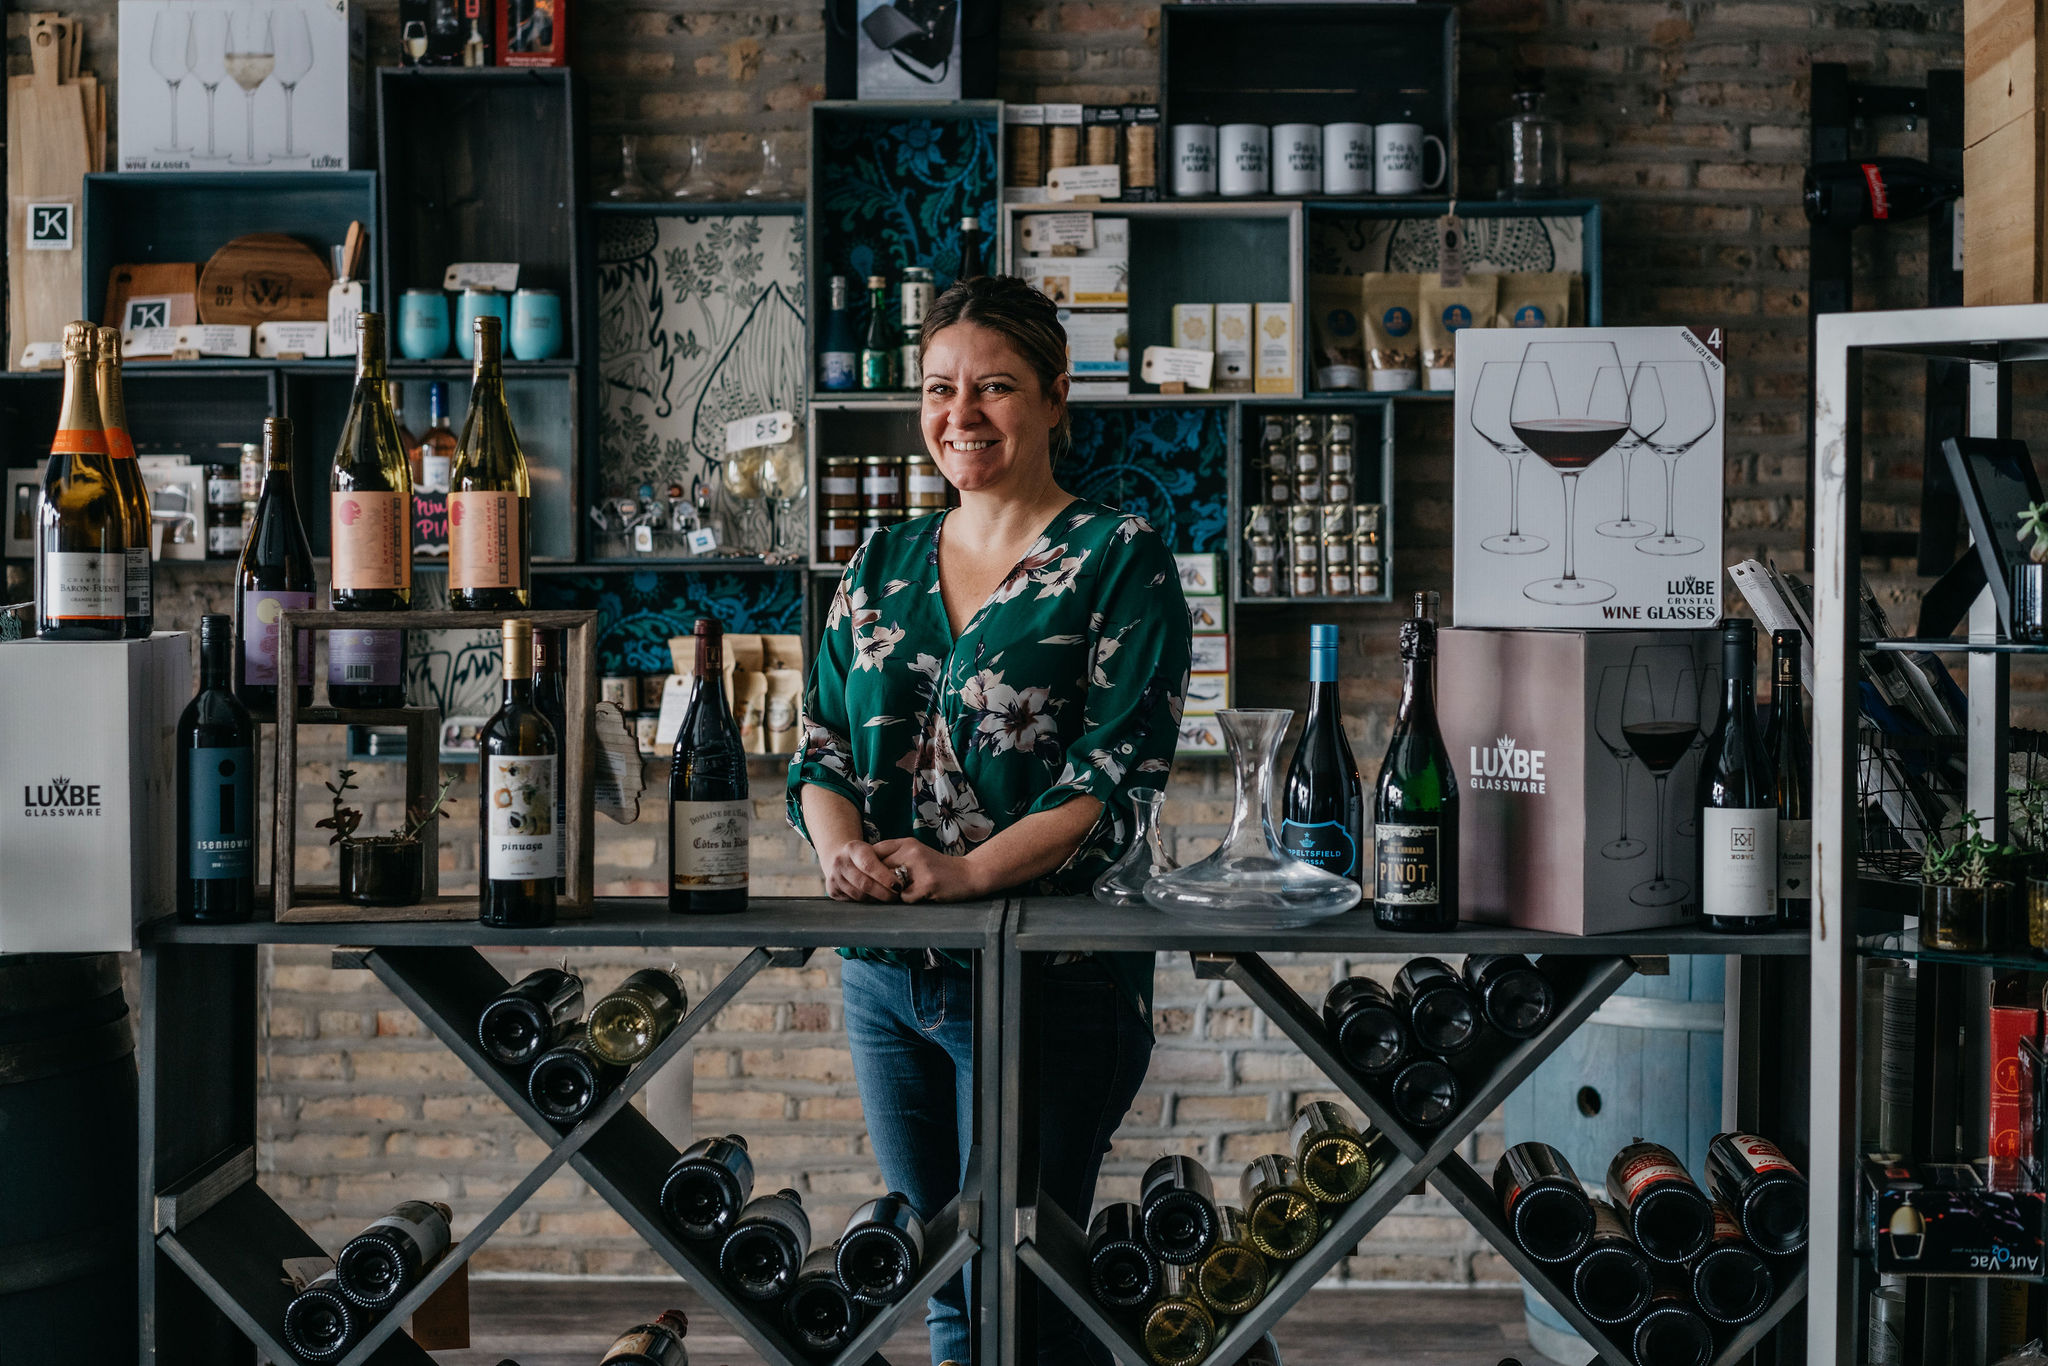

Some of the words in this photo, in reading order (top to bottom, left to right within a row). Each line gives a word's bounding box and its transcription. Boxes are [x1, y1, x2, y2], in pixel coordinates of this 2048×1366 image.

[1681, 331, 1699, 349] 650ml
[1707, 328, 1722, 349] 4
[1667, 580, 1715, 595] LUXBE
[1667, 597, 1715, 605] CRYSTAL
[1602, 606, 1642, 620] WINE
[1646, 606, 1716, 620] GLASSES
[1470, 745, 1546, 781] LUXBE
[1470, 778, 1546, 795] GLASSWARE
[25, 784, 101, 807] LUXBE
[25, 808, 102, 817] GLASSWARE
[1380, 862, 1429, 883] PINOT
